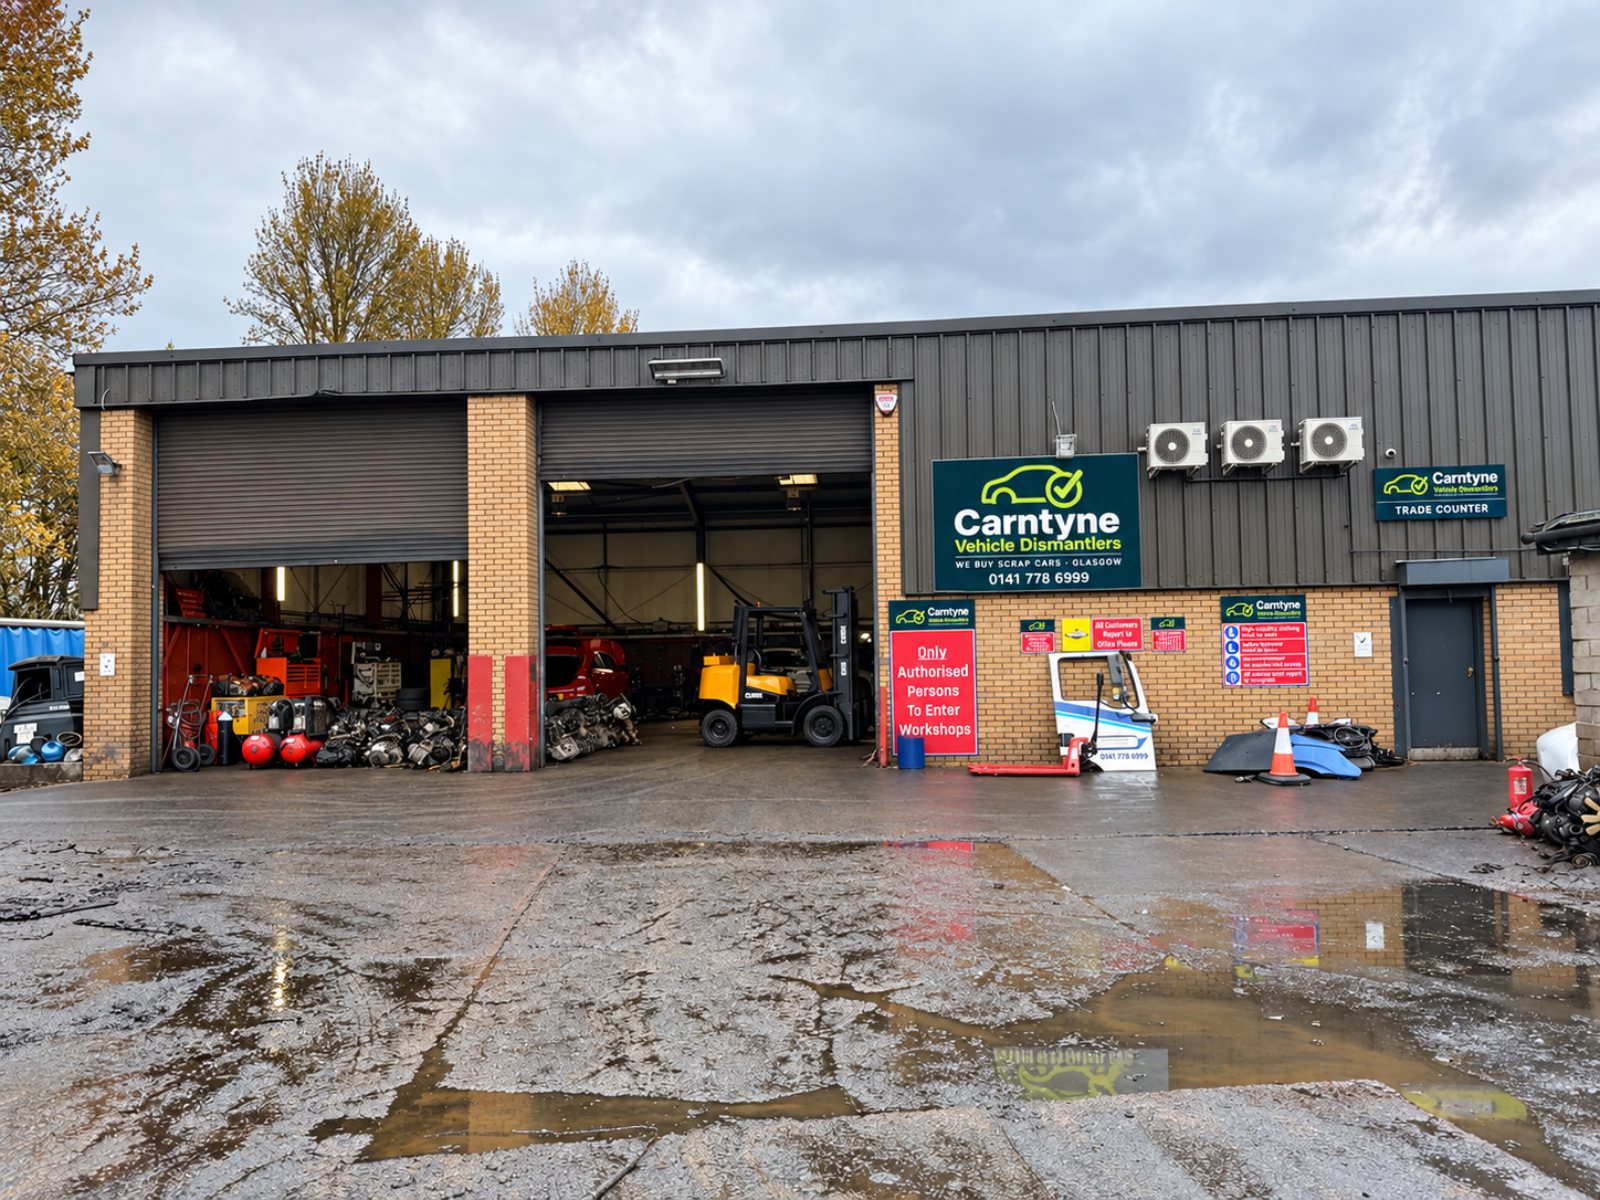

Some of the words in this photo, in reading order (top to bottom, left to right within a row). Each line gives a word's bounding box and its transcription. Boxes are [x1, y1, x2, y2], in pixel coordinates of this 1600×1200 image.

[1432, 471, 1498, 486] Carntyne
[1395, 505, 1432, 515] TRADE
[1435, 504, 1488, 514] COUNTER
[954, 508, 1120, 540] Carntyne
[954, 538, 1015, 553] Vehicle
[1020, 536, 1122, 552] Dismantlers
[955, 560, 970, 569] WE
[974, 560, 994, 568] BUY
[997, 560, 1031, 568] SCRAP
[1034, 559, 1061, 568] CARS
[1072, 558, 1122, 567] GLASGOW
[988, 573, 1020, 586] 0141
[1025, 572, 1051, 585] 778
[1054, 571, 1090, 584] 6999
[927, 607, 969, 617] Carntyne
[1256, 600, 1301, 612] Carntyne
[917, 645, 947, 659] Only
[897, 664, 969, 679] Authorised
[907, 685, 960, 698] Persons
[907, 704, 921, 717] To
[925, 704, 960, 717] Enter
[899, 723, 971, 738] Workshops
